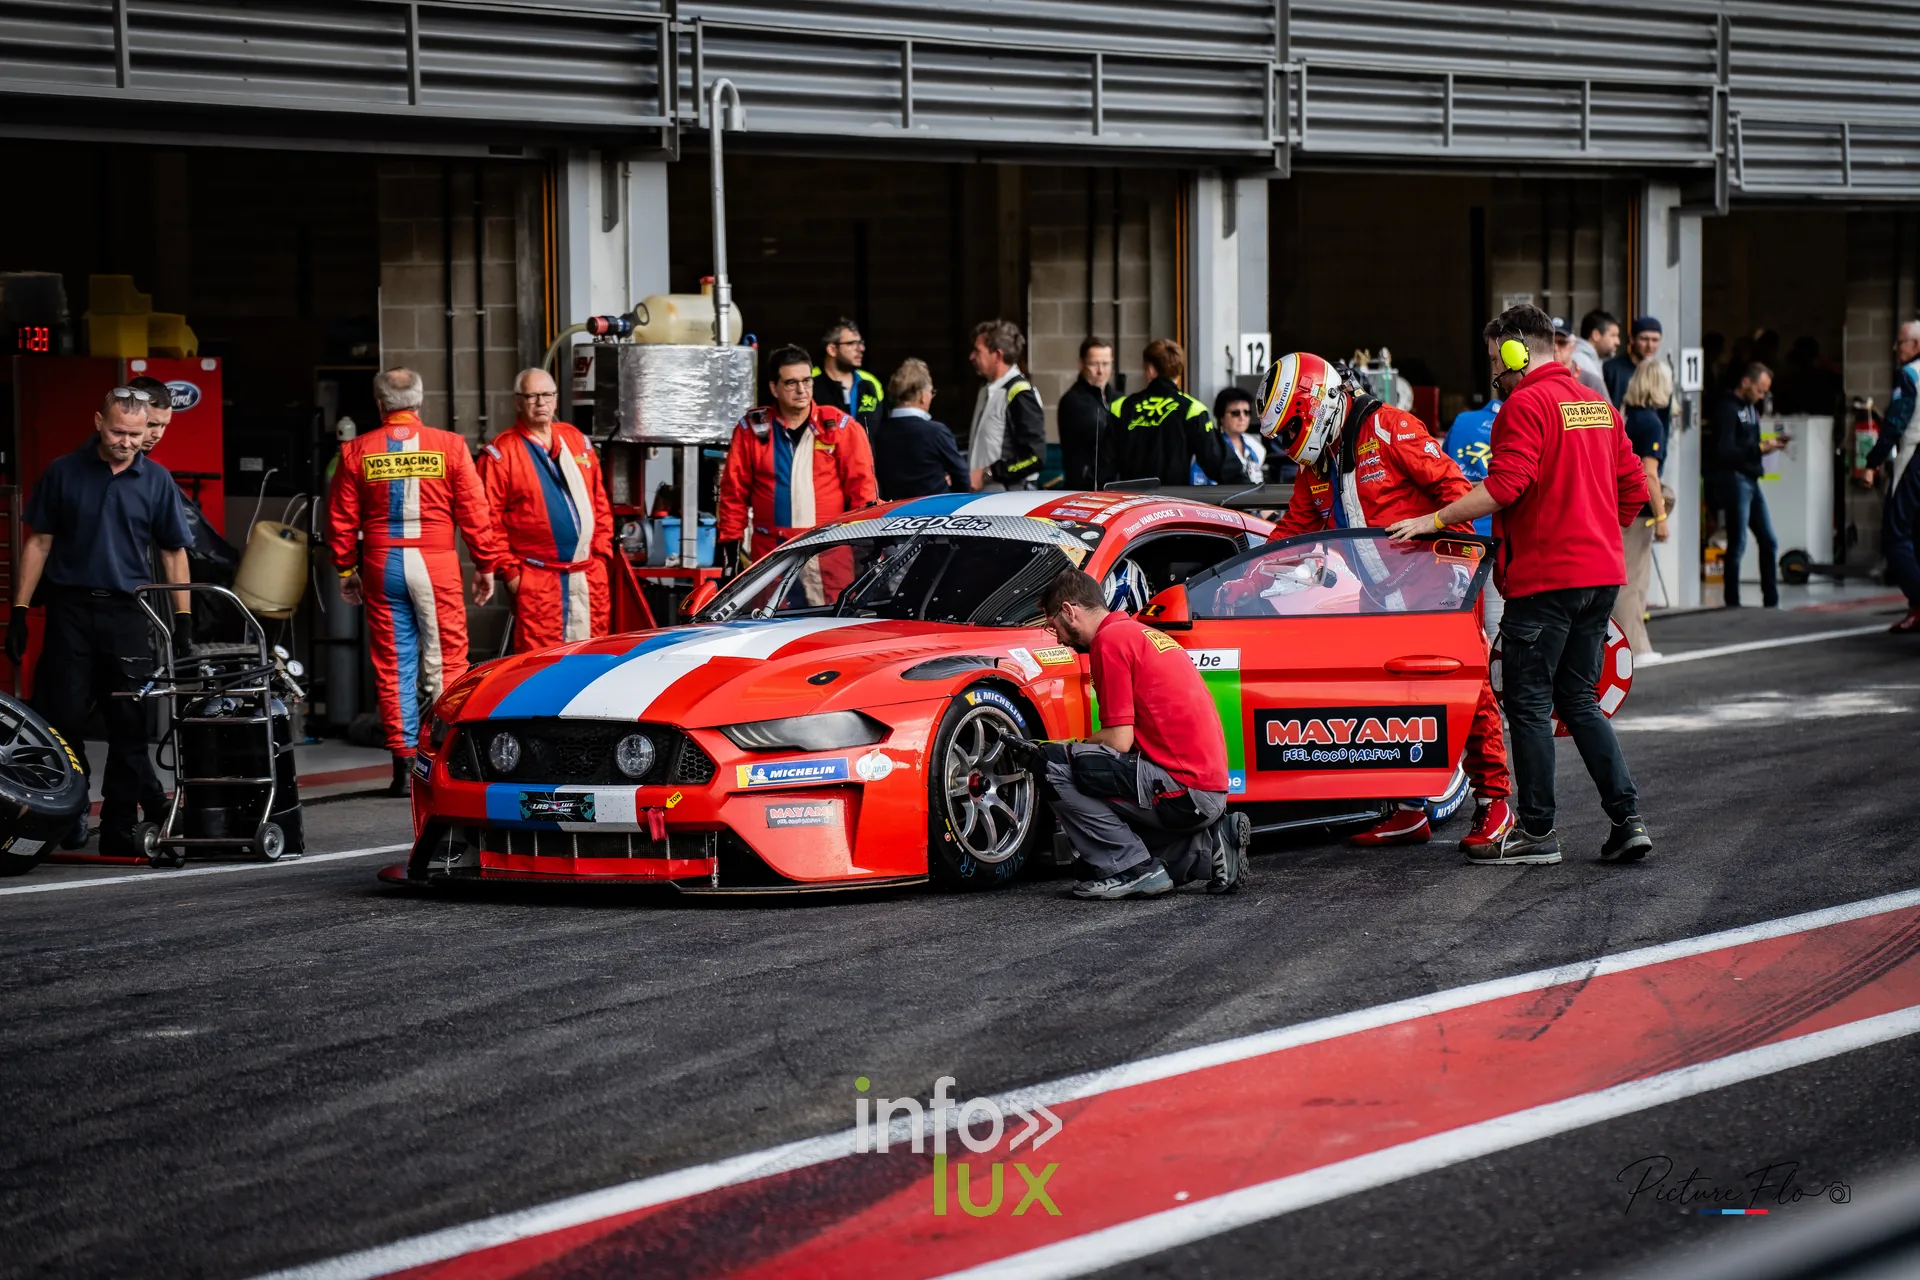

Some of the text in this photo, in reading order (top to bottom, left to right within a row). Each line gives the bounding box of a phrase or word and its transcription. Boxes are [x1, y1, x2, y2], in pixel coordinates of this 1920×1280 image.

[1247, 342, 1265, 374] 12
[1686, 356, 1698, 382] 11
[1275, 382, 1290, 414] Corona
[1564, 407, 1607, 416] VDS RACING
[368, 456, 438, 468] VDS RACING
[370, 467, 438, 475] ADVENTURES
[883, 516, 991, 531] BGDC.be
[1123, 521, 1141, 536] Thomas
[1139, 509, 1176, 525] VANLOOCKE
[1190, 653, 1221, 667] .be
[983, 691, 1023, 723] MICHELIN
[1266, 717, 1437, 745] MAYAMI
[1283, 748, 1400, 762] FEEL GOOD PARFUM
[770, 766, 835, 778] MICHELIN
[670, 792, 681, 804] TOW
[770, 806, 833, 819] MAYAMI
